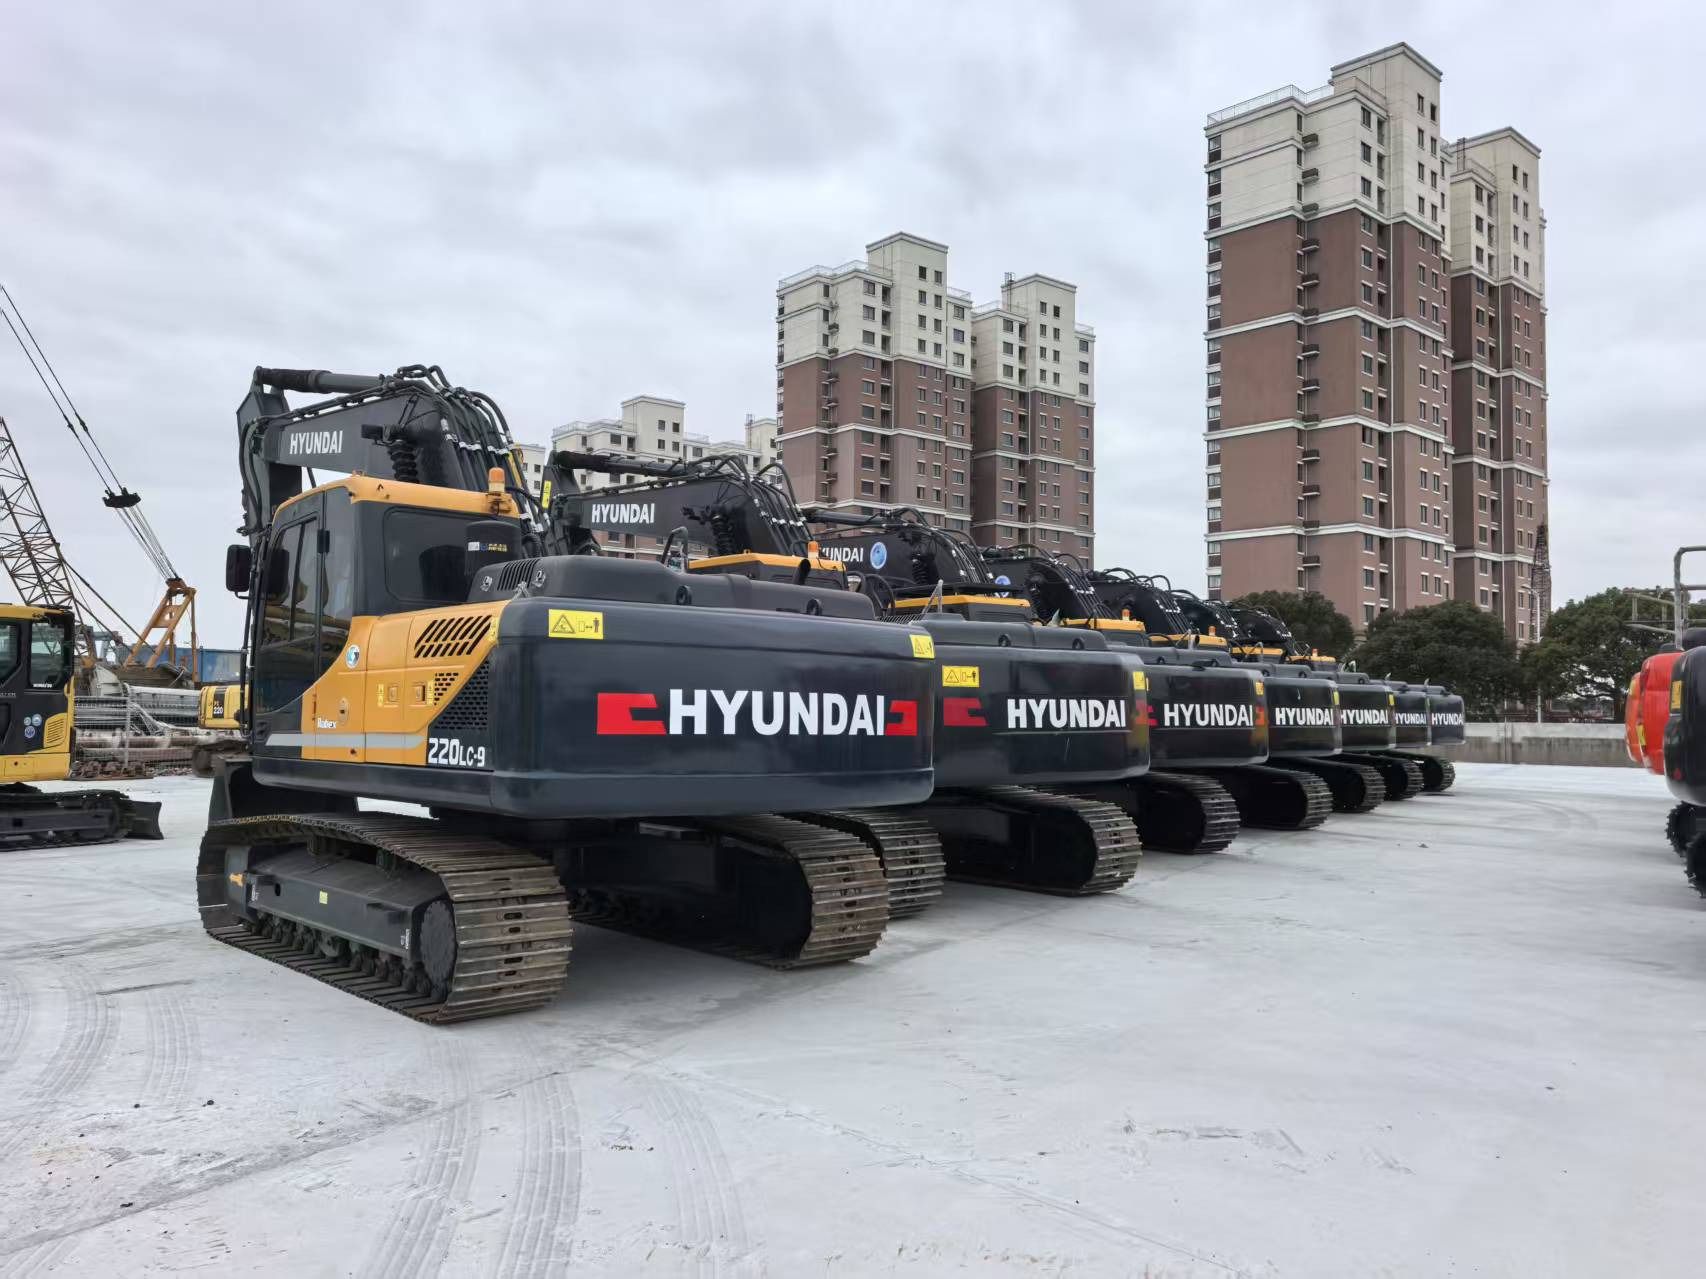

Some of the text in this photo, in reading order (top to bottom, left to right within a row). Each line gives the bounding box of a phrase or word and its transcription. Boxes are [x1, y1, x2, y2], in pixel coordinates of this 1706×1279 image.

[289, 430, 344, 456] HYUNDAI
[591, 502, 655, 525] HYUNDAI
[213, 706, 224, 715] 220
[669, 689, 885, 736] HYUNDAI
[1007, 698, 1127, 729] HYUNDAI
[1163, 703, 1254, 727] HYUNDAI
[1275, 707, 1334, 726] HYUNDAI
[1340, 709, 1389, 725] HYUNDAI
[428, 737, 486, 767] 220LC-9
